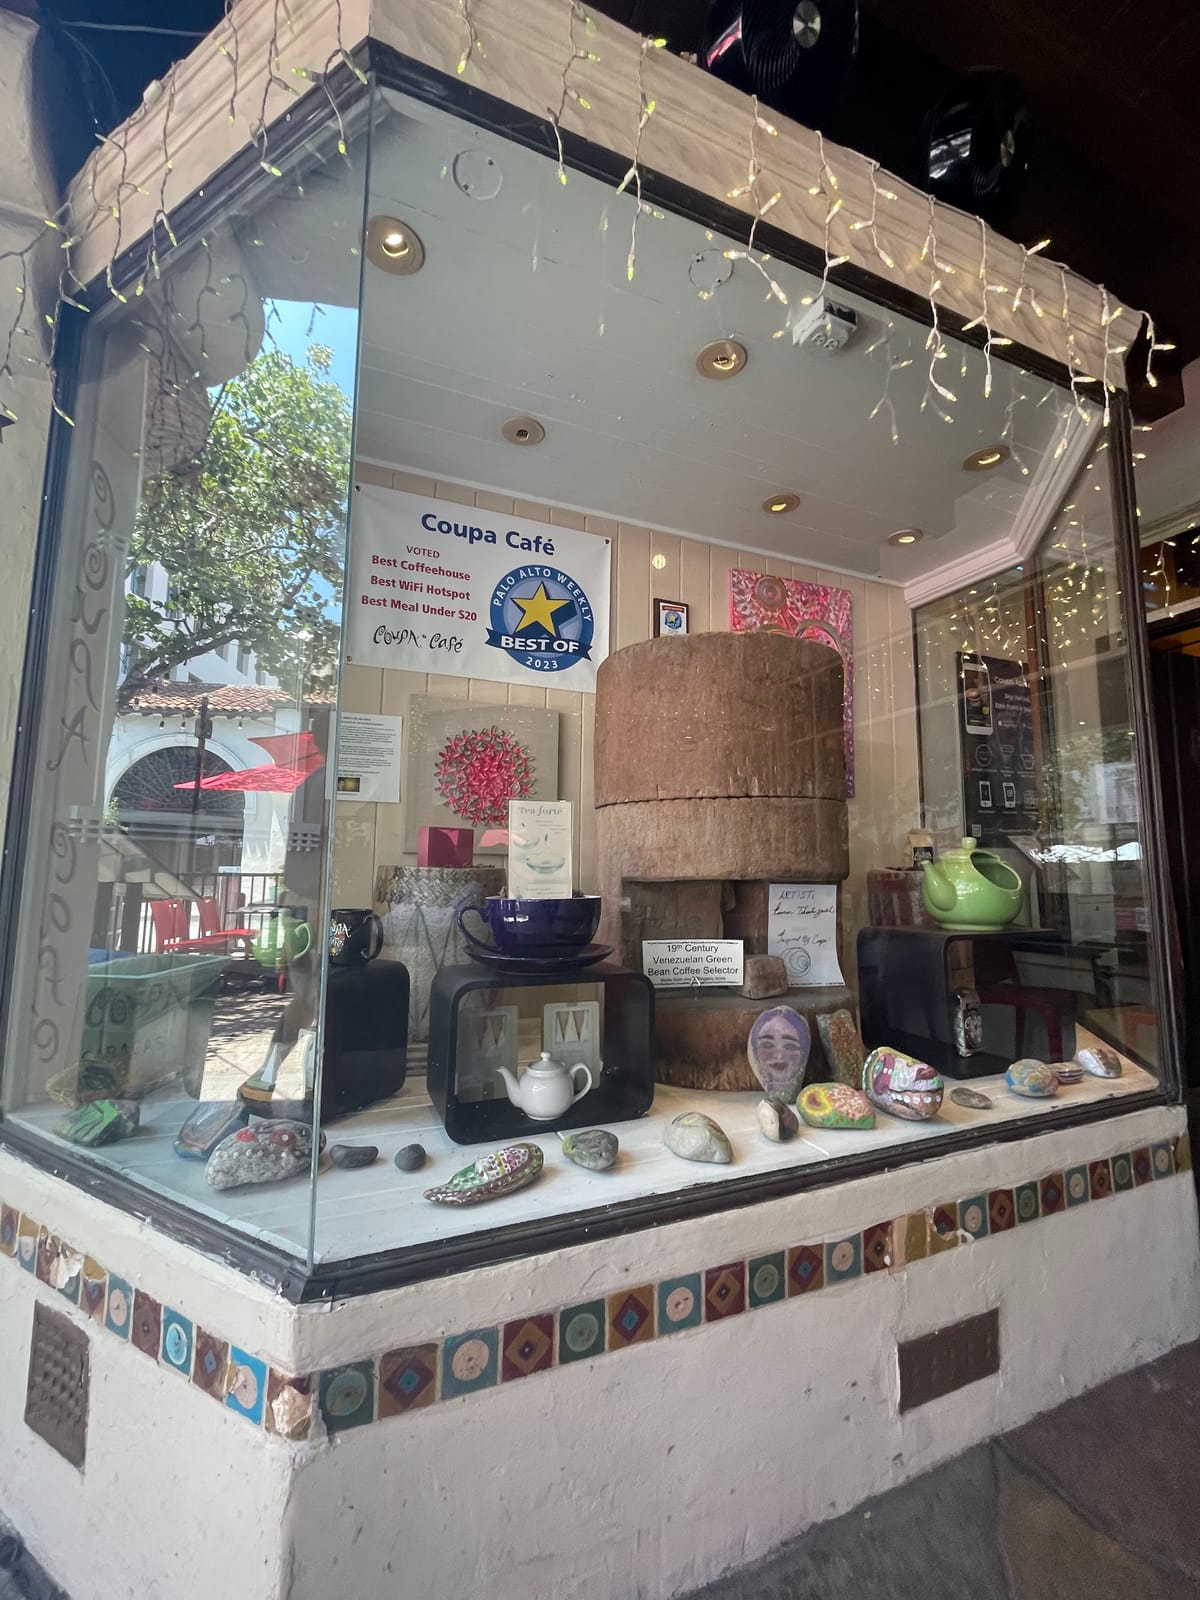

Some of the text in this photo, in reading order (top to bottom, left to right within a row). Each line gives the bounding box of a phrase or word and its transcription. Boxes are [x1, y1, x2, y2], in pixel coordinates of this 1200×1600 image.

[421, 513, 555, 556] Coupa Café
[406, 545, 440, 558] VOTED
[372, 555, 471, 581] Best Coffeehouse
[371, 575, 470, 600] Best WiFi Hotspot
[493, 567, 592, 621] PALO ALTO WEEKLY
[361, 595, 477, 621] Best Meal Under $20
[501, 635, 579, 653] BEST OF
[526, 656, 558, 669] 2023
[667, 944, 719, 953] 19th Century
[653, 955, 733, 965] Venezuelan Green
[647, 966, 739, 976] Bean Coffee Selector
